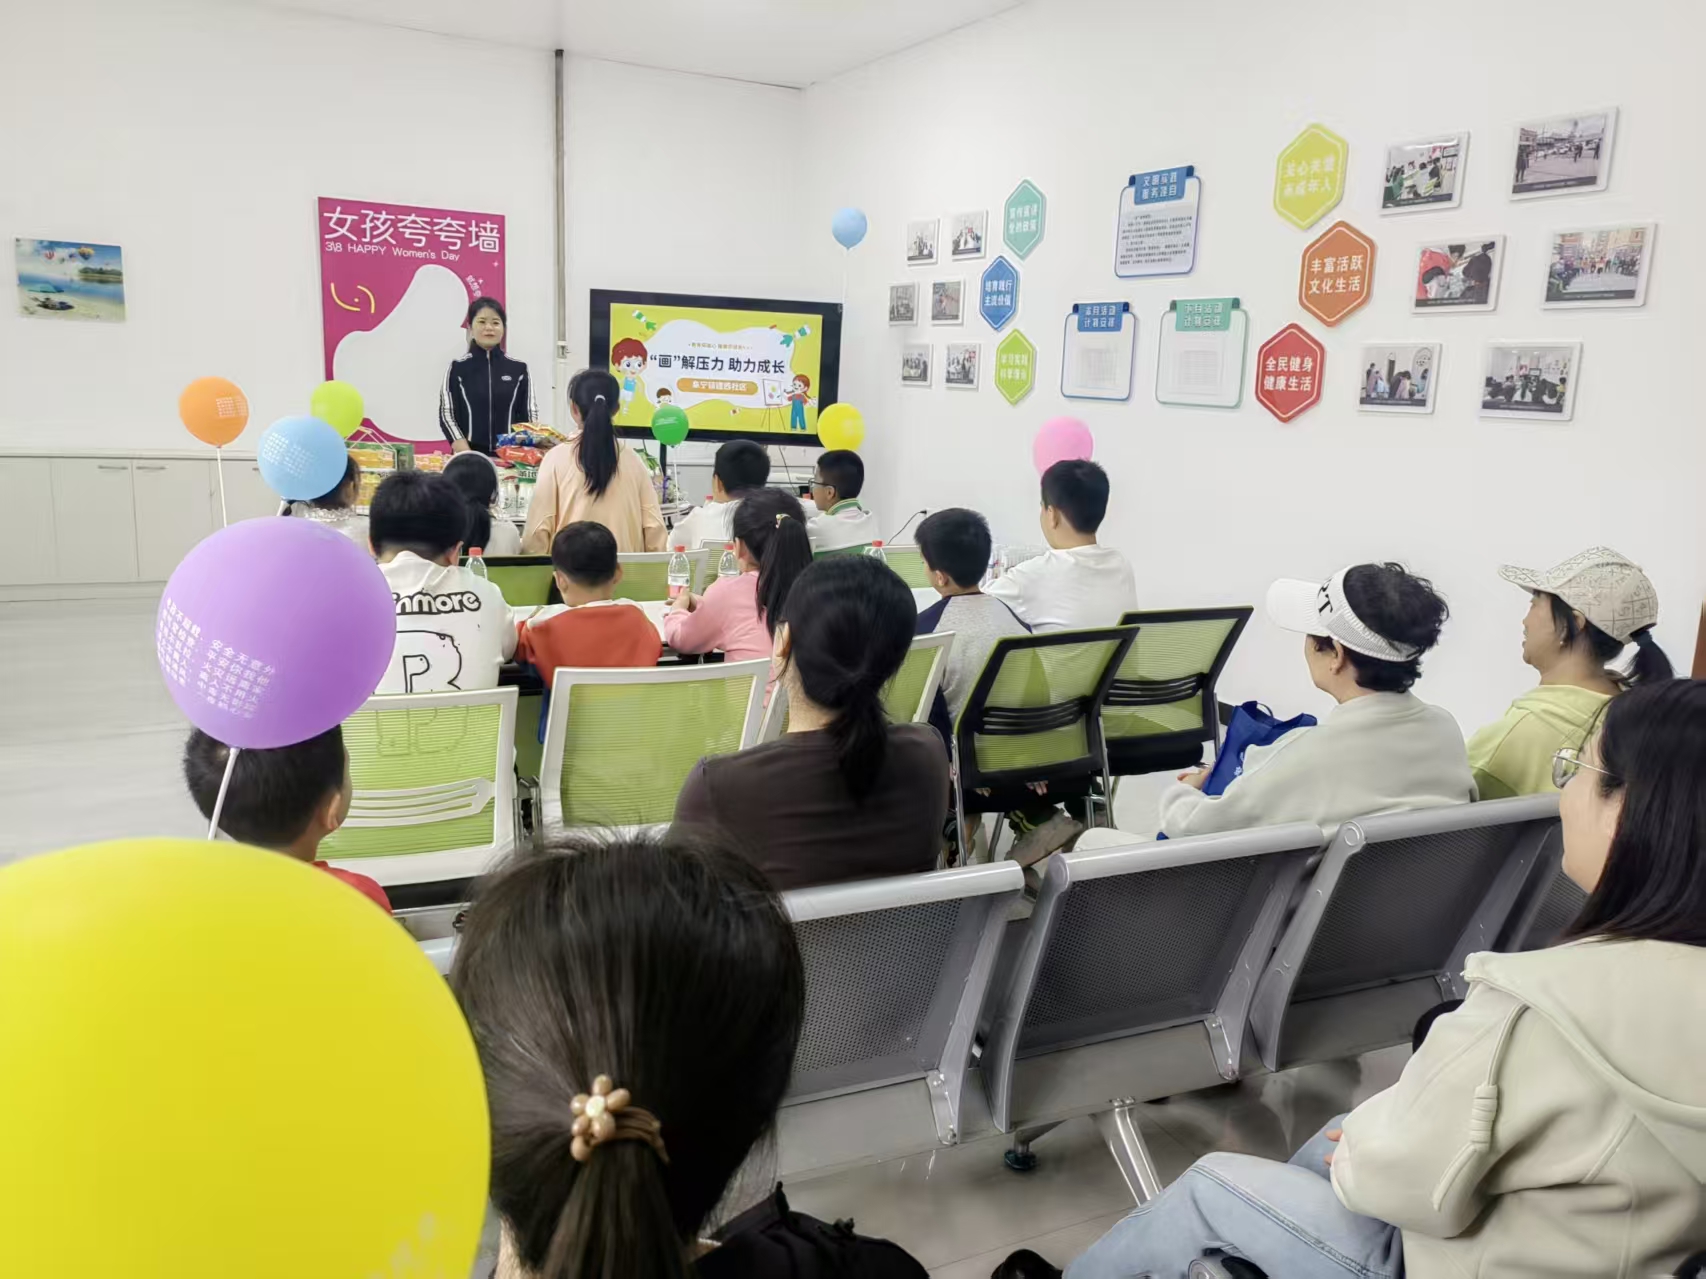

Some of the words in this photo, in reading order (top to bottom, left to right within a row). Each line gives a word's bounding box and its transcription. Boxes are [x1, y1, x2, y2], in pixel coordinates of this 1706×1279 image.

[323, 206, 501, 253] 女孩夸夸墙
[348, 243, 386, 255] HAPPY
[392, 246, 436, 260] Women's
[441, 250, 460, 262] Day
[1310, 255, 1363, 273] 丰富活跃
[1309, 275, 1361, 295] 文化生活
[650, 354, 724, 372] “画”解压力
[728, 357, 785, 374] 助力成长
[1265, 355, 1313, 372] 全民健身
[1263, 375, 1312, 392] 健康生活
[393, 590, 481, 615] nmore
